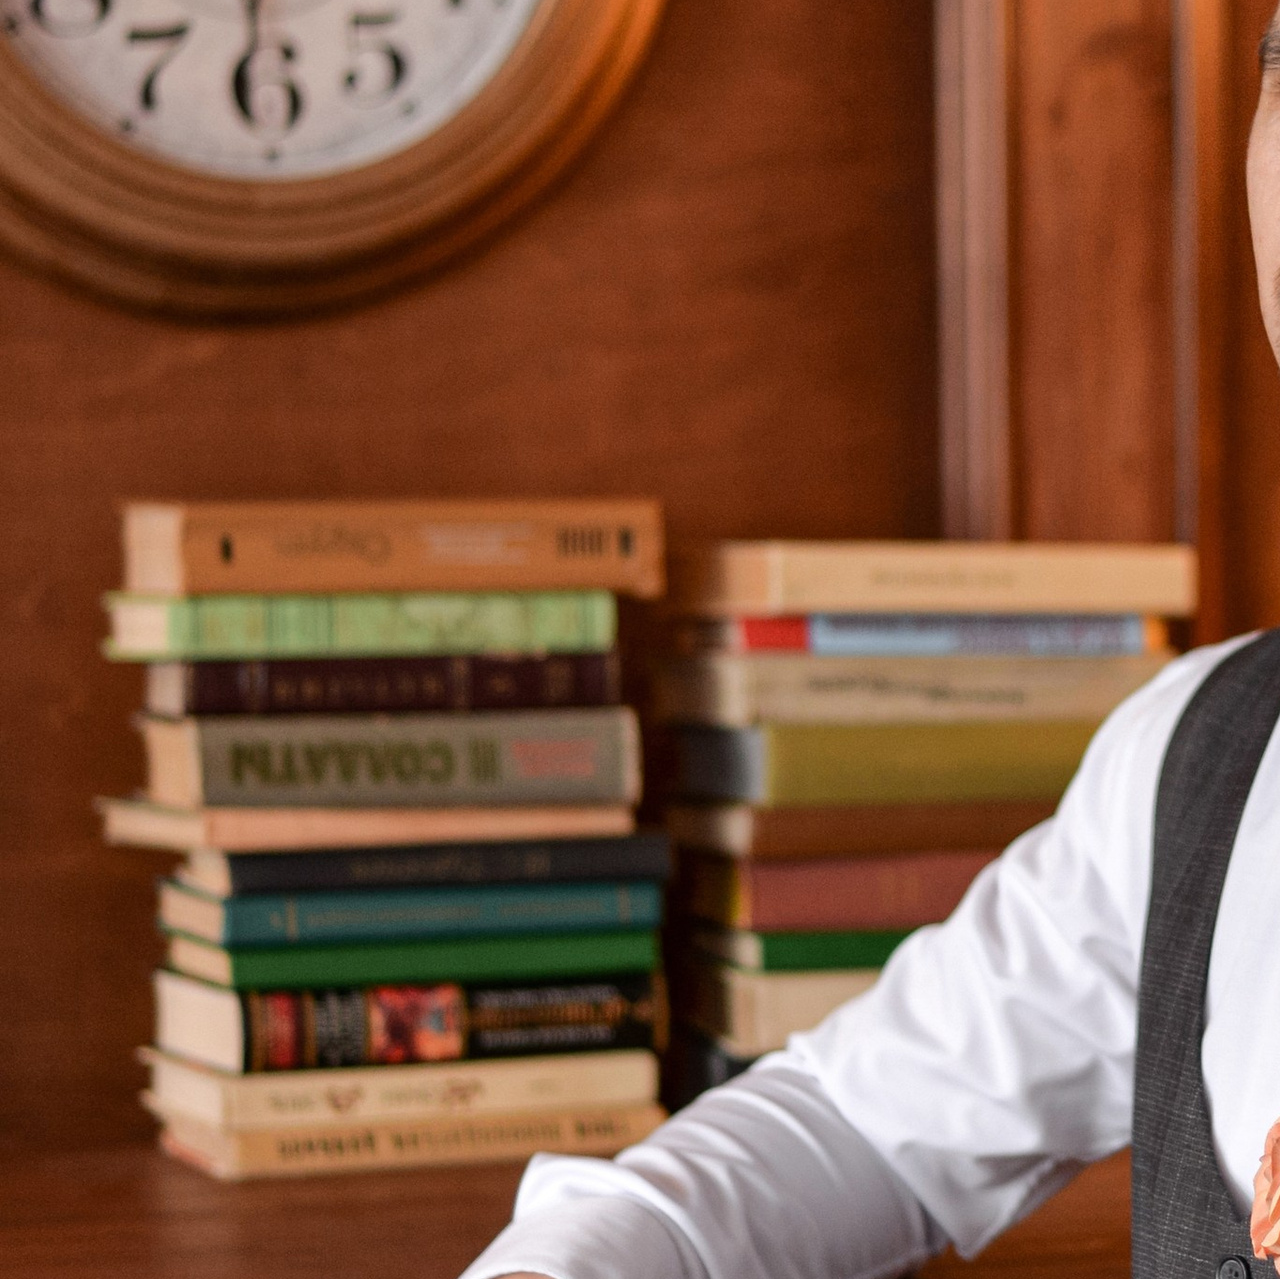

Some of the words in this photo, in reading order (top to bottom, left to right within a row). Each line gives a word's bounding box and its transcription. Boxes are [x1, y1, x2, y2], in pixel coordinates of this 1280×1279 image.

[128, 25, 191, 111] 7
[231, 42, 302, 142] 6
[344, 14, 406, 108] 5
